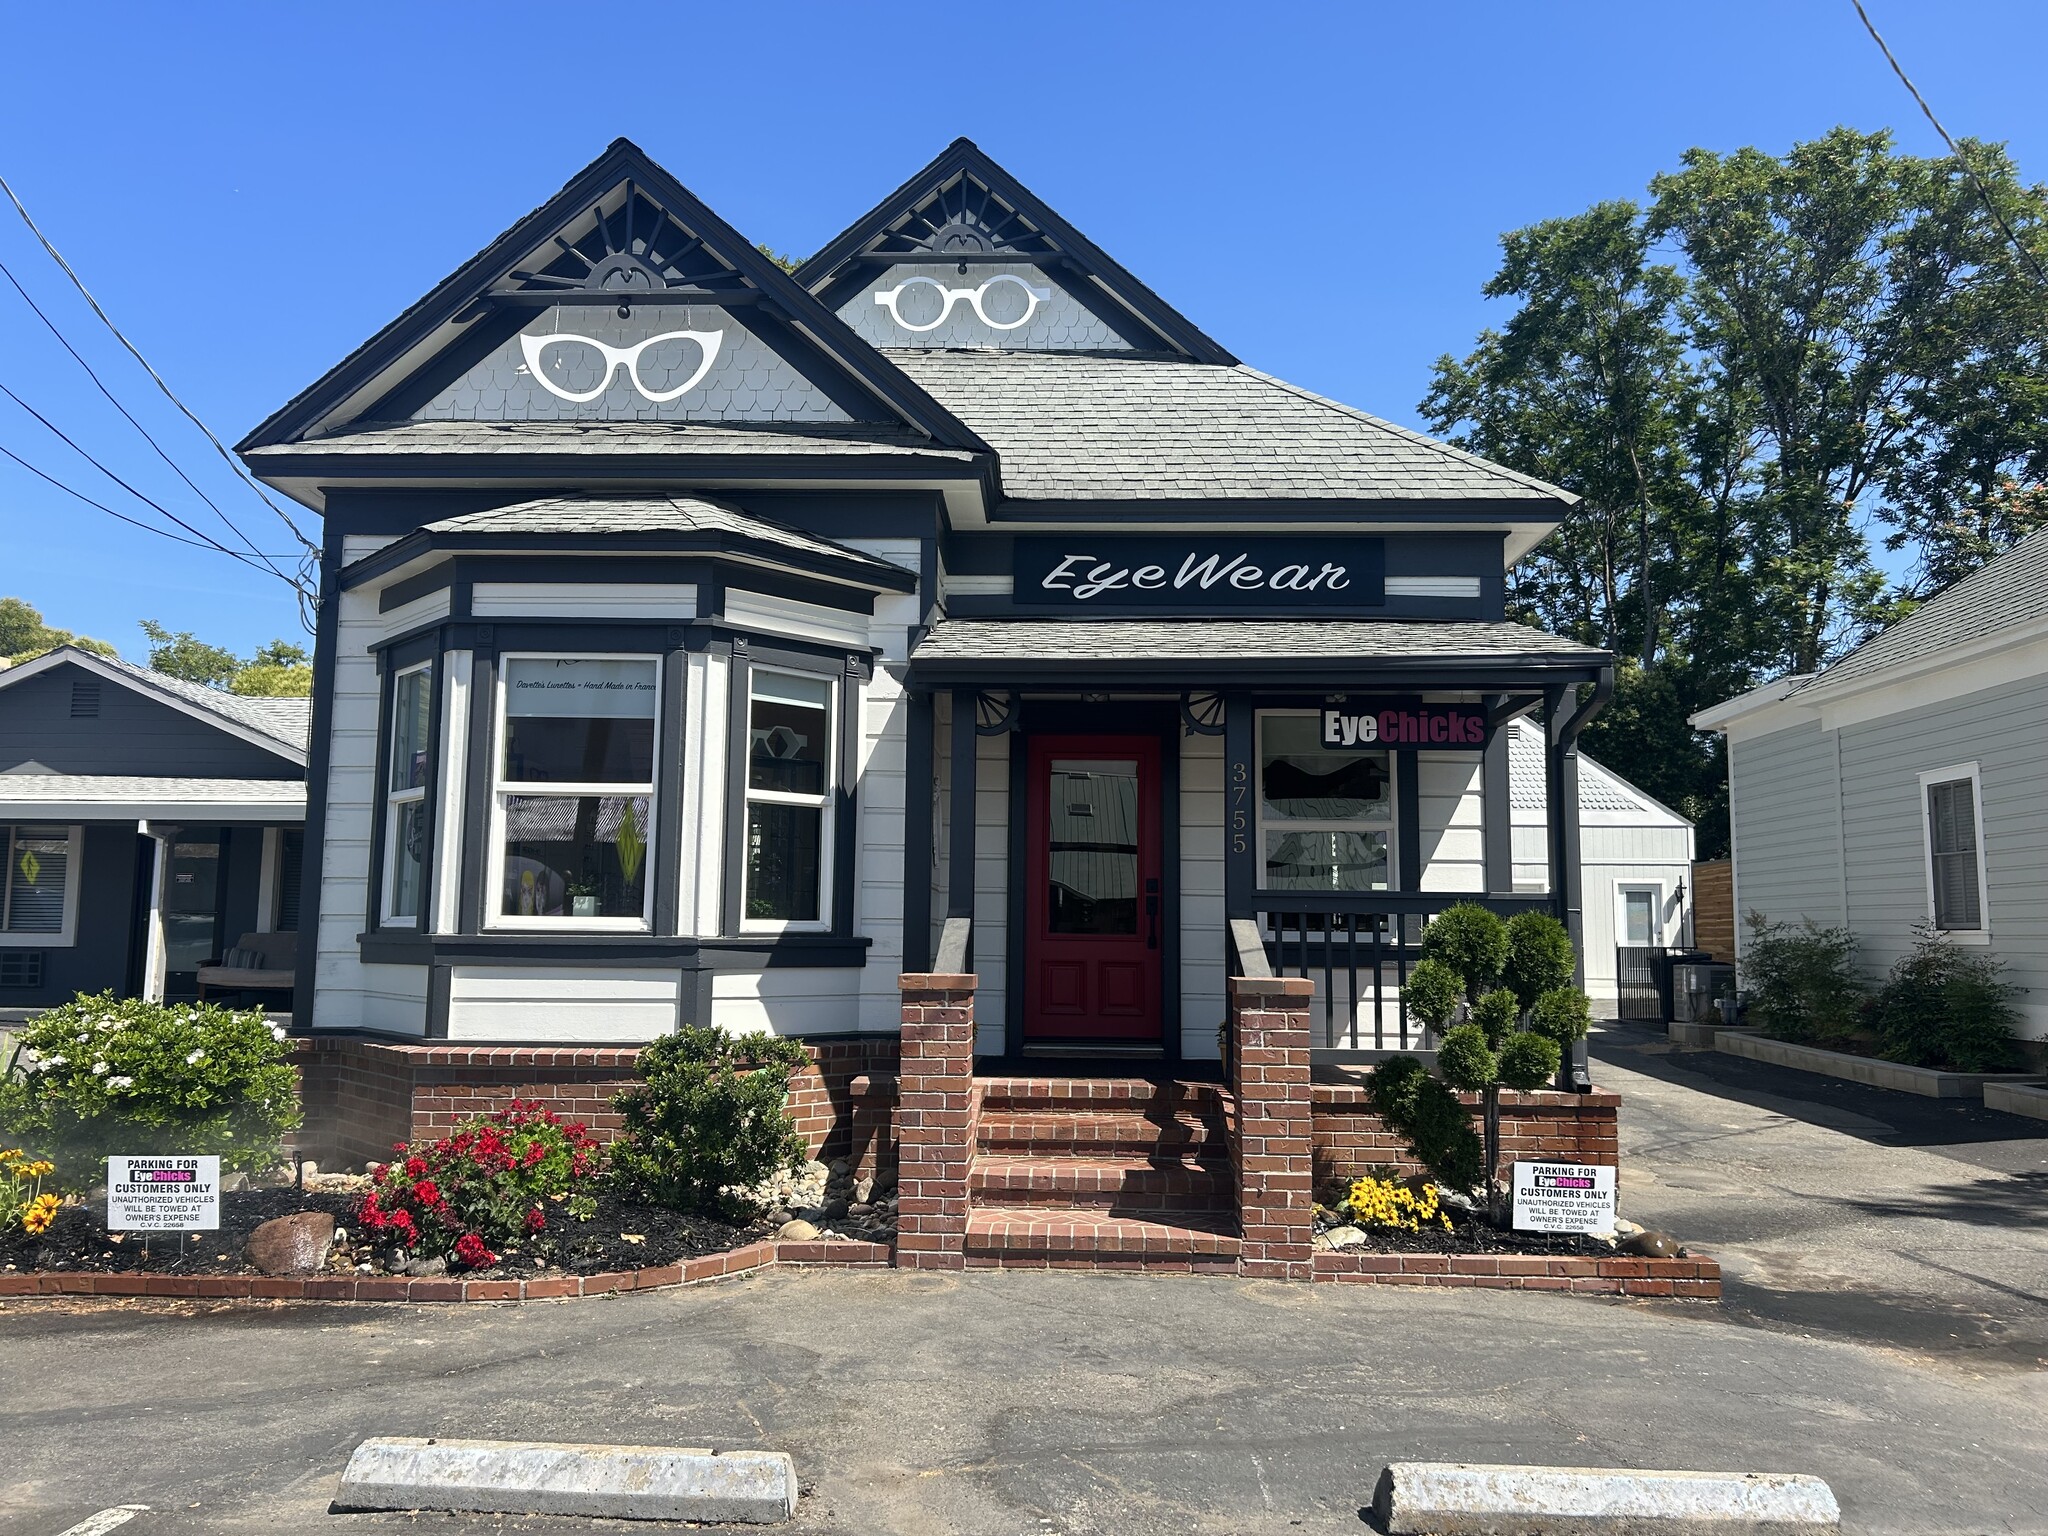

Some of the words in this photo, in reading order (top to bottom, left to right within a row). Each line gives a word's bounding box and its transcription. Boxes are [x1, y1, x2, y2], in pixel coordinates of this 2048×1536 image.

[1041, 552, 1350, 599] EyeWear
[546, 681, 575, 689] Lunettes
[583, 681, 605, 690] Hand
[604, 681, 625, 690] Made
[625, 682, 635, 690] in
[1325, 710, 1485, 746] EyeChicks
[1232, 763, 1247, 853] 3755
[127, 1159, 173, 1169] PARKING
[176, 1159, 198, 1169] FOR
[134, 1170, 191, 1182] EyeChicks
[1532, 1166, 1575, 1176] PARKING
[1577, 1168, 1597, 1177] FOR
[1538, 1176, 1591, 1188] EyeChicks
[115, 1183, 180, 1193] CUSTOMERS
[183, 1183, 211, 1193] ONLY
[1520, 1187, 1581, 1199] CUSTOMERS
[1584, 1190, 1608, 1199] ONLY
[111, 1195, 173, 1203] UNAUTHORIZED
[174, 1195, 215, 1203] VEHICLES
[1517, 1198, 1575, 1208] UNAUTHORIZED
[1576, 1201, 1611, 1209] VEHICLES
[123, 1204, 143, 1212] WILL
[190, 1204, 202, 1212] AT
[1528, 1207, 1547, 1215] WILL
[1561, 1209, 1588, 1217] TOWED
[1589, 1209, 1600, 1217] AT
[125, 1213, 161, 1221] OWNER'S
[163, 1213, 200, 1221] EXPENSE
[1529, 1215, 1564, 1224] OWNER'S
[1565, 1217, 1599, 1225] EXPENSE
